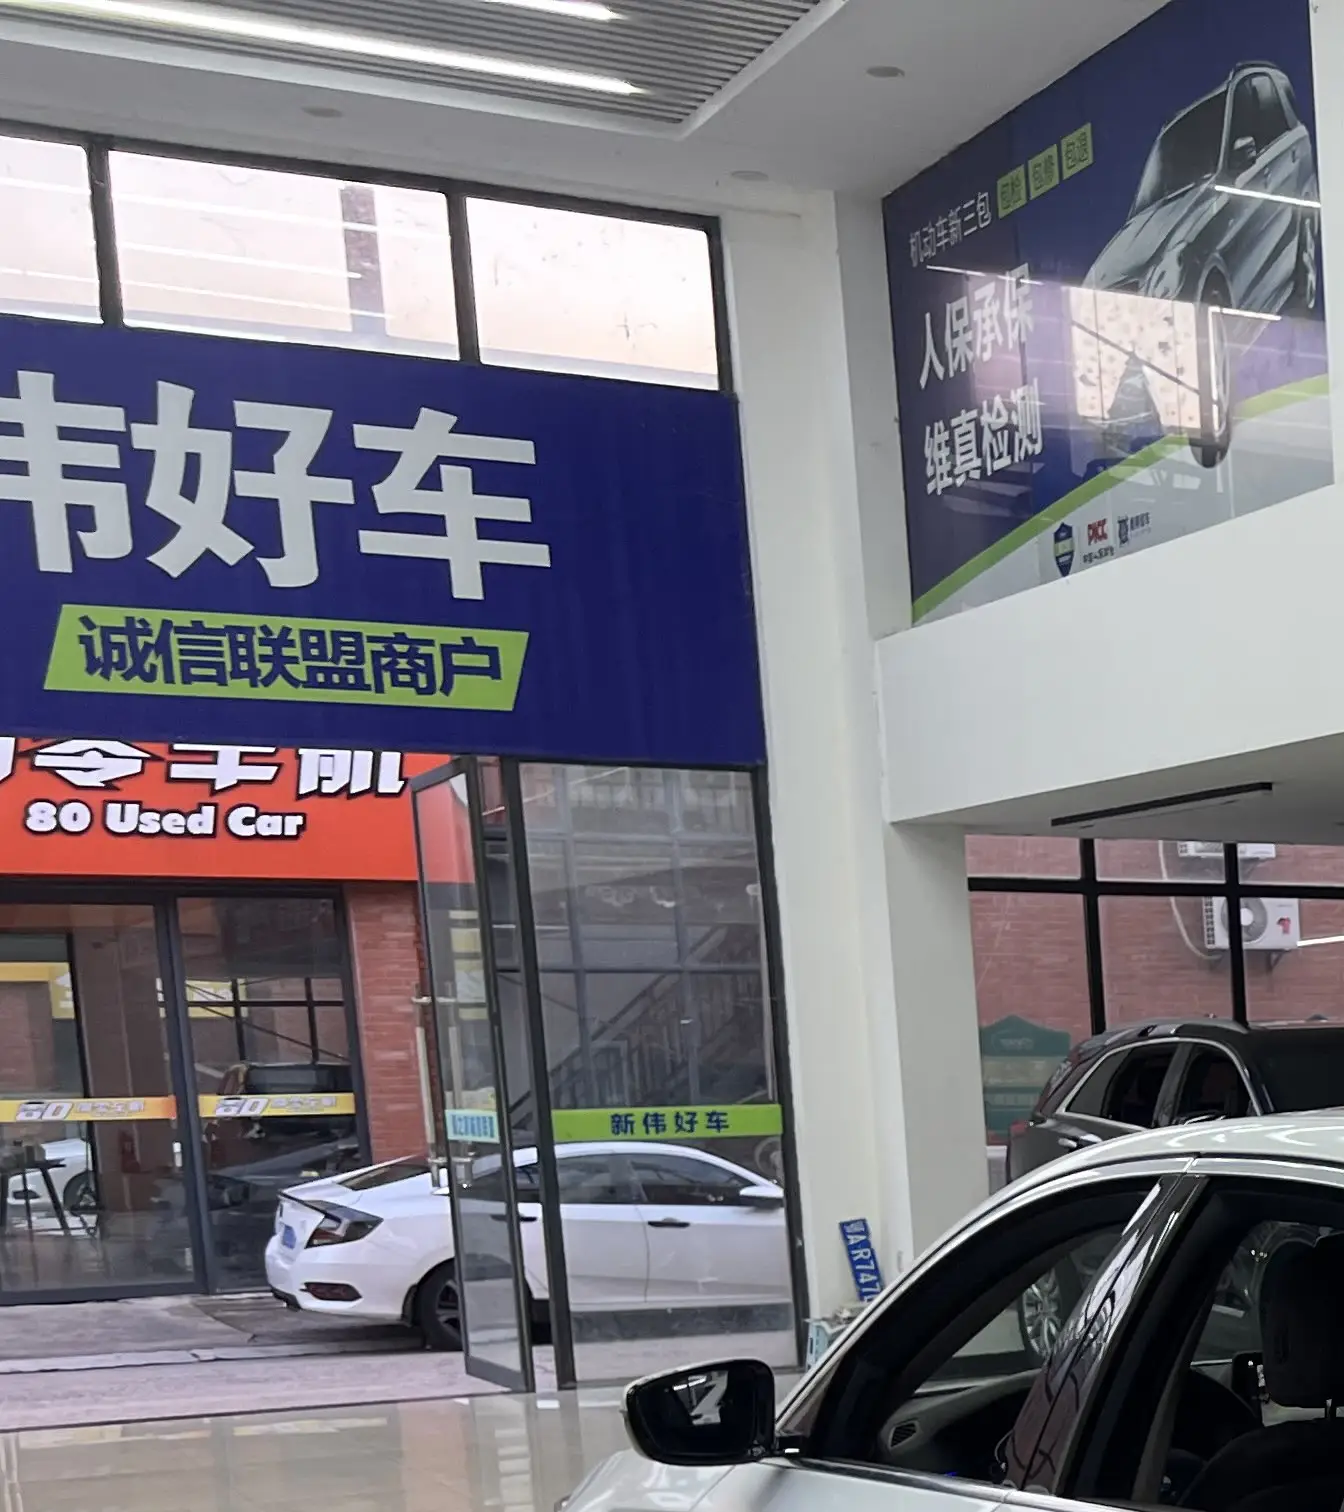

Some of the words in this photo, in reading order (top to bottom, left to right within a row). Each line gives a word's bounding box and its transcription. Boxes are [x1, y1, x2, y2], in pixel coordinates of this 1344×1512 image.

[910, 191, 991, 267] 机动车新三包
[919, 262, 1034, 390] 人保承保
[924, 377, 1043, 495] 维真检测
[78, 615, 502, 697] 诚信联盟商户
[26, 801, 91, 833] 80
[105, 802, 216, 836] Used
[227, 805, 304, 837] Car
[610, 1111, 730, 1135] 新伟好车
